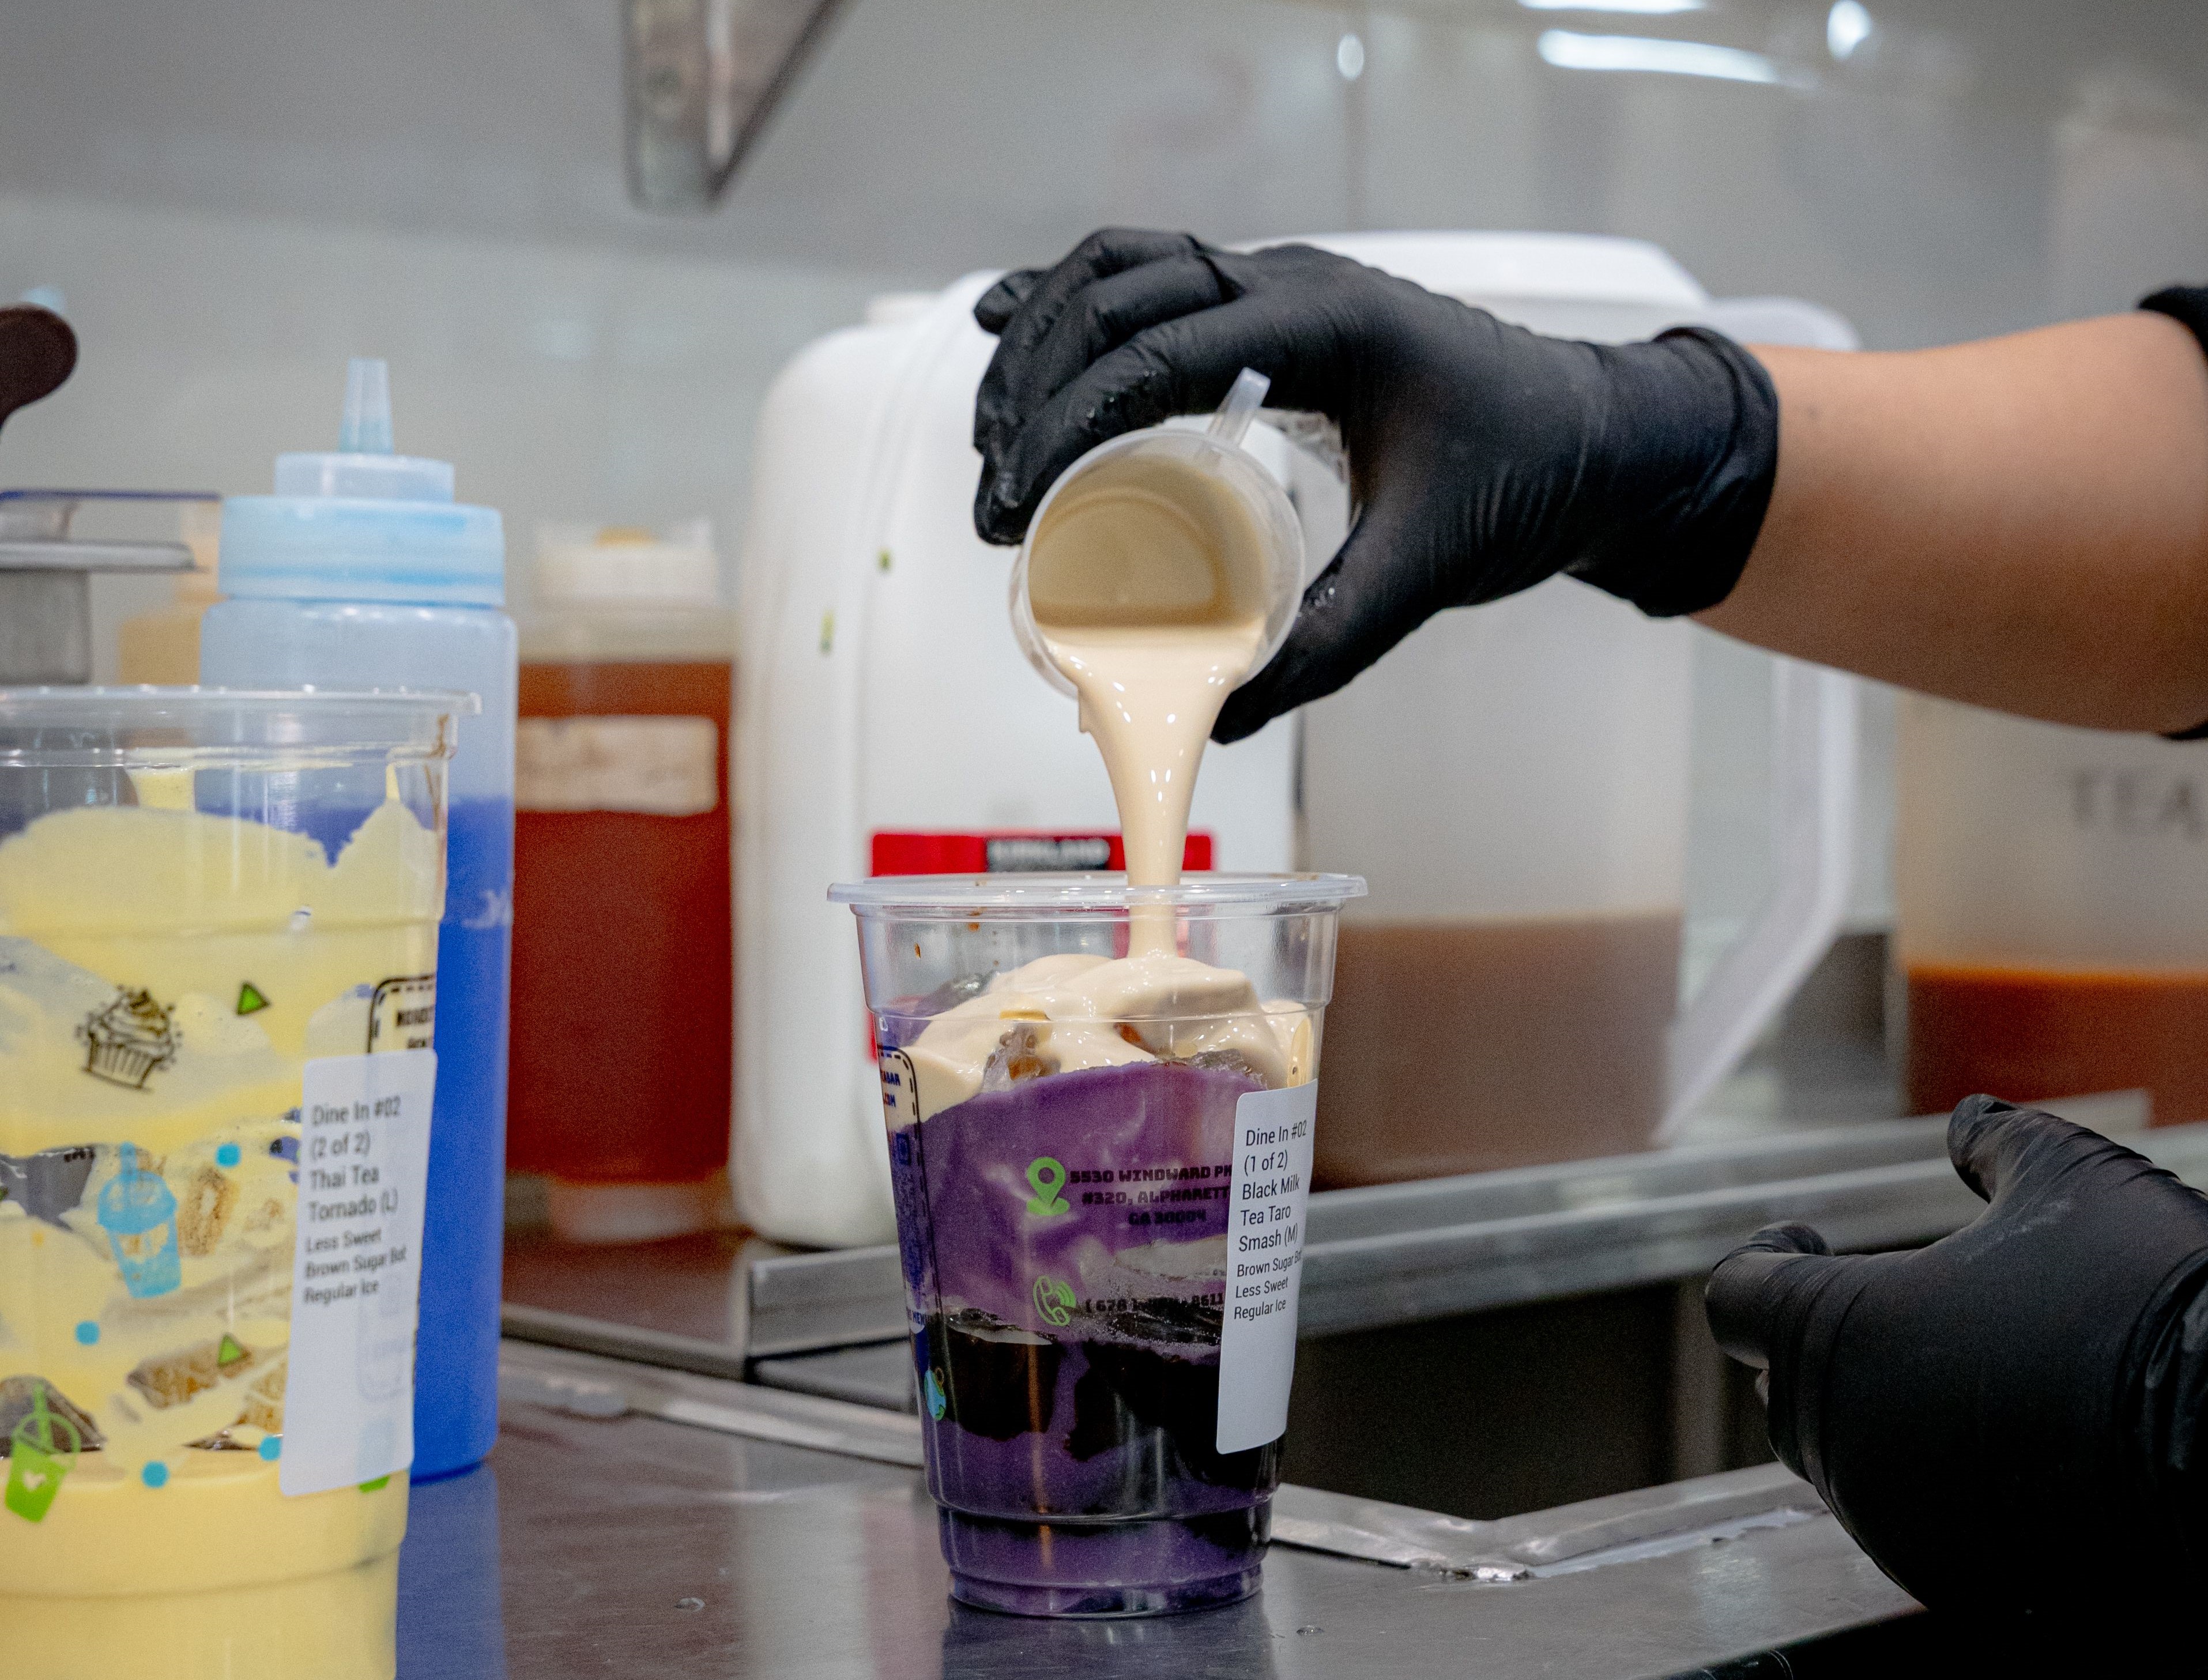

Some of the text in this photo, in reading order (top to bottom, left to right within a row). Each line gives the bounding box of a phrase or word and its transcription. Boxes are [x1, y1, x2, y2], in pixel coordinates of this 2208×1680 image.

[313, 1095, 401, 1125] Dine In #02
[311, 1128, 371, 1161] (2 of 2)
[1246, 1120, 1307, 1146] Dine In #02
[1069, 1170, 1114, 1183] 5530
[1118, 1166, 1211, 1182] WINDWARD
[1244, 1149, 1288, 1177] (1 of 2)
[311, 1163, 379, 1190] Thai Tea
[1242, 1174, 1300, 1200] Black Milk
[308, 1193, 376, 1223] Tornado
[1082, 1186, 1230, 1206] #320, ALPHARETT
[1241, 1206, 1291, 1226] Tea Taro
[306, 1227, 381, 1255] Less Sweet
[1239, 1223, 1298, 1252] Smash (M)
[306, 1261, 350, 1280] Brown
[355, 1254, 387, 1272] Sugar
[1237, 1263, 1270, 1277] Brown
[1273, 1255, 1293, 1272] Sugar
[304, 1279, 379, 1306] Regular Ice
[1236, 1276, 1288, 1298] Less Sweet
[1234, 1299, 1286, 1321] Regular Ice
